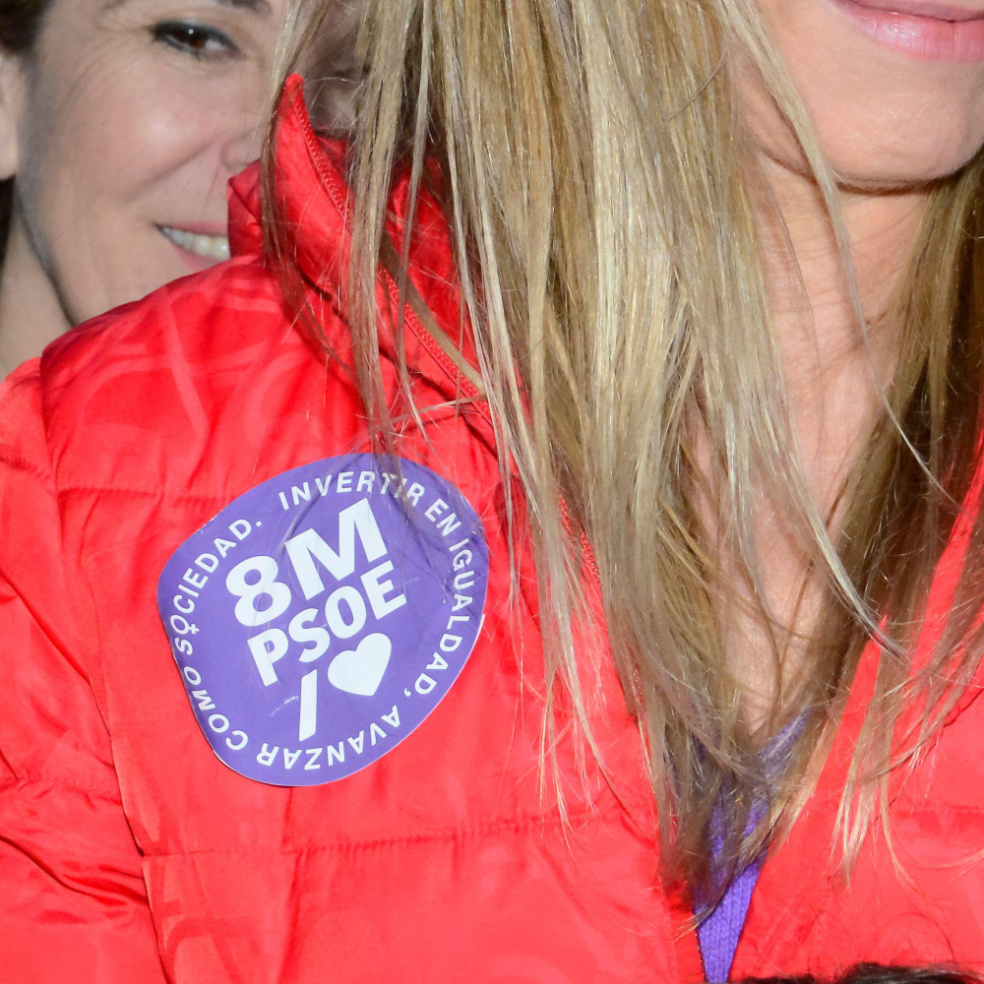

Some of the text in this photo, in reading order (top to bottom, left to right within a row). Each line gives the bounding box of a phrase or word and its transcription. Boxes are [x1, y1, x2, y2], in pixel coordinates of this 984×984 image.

[170, 470, 475, 771] INVERTIR EN IGUALDAD, AVANZAR COMO SOCIEDAD.
[225, 497, 388, 627] 8M
[246, 560, 407, 687] PSOE
